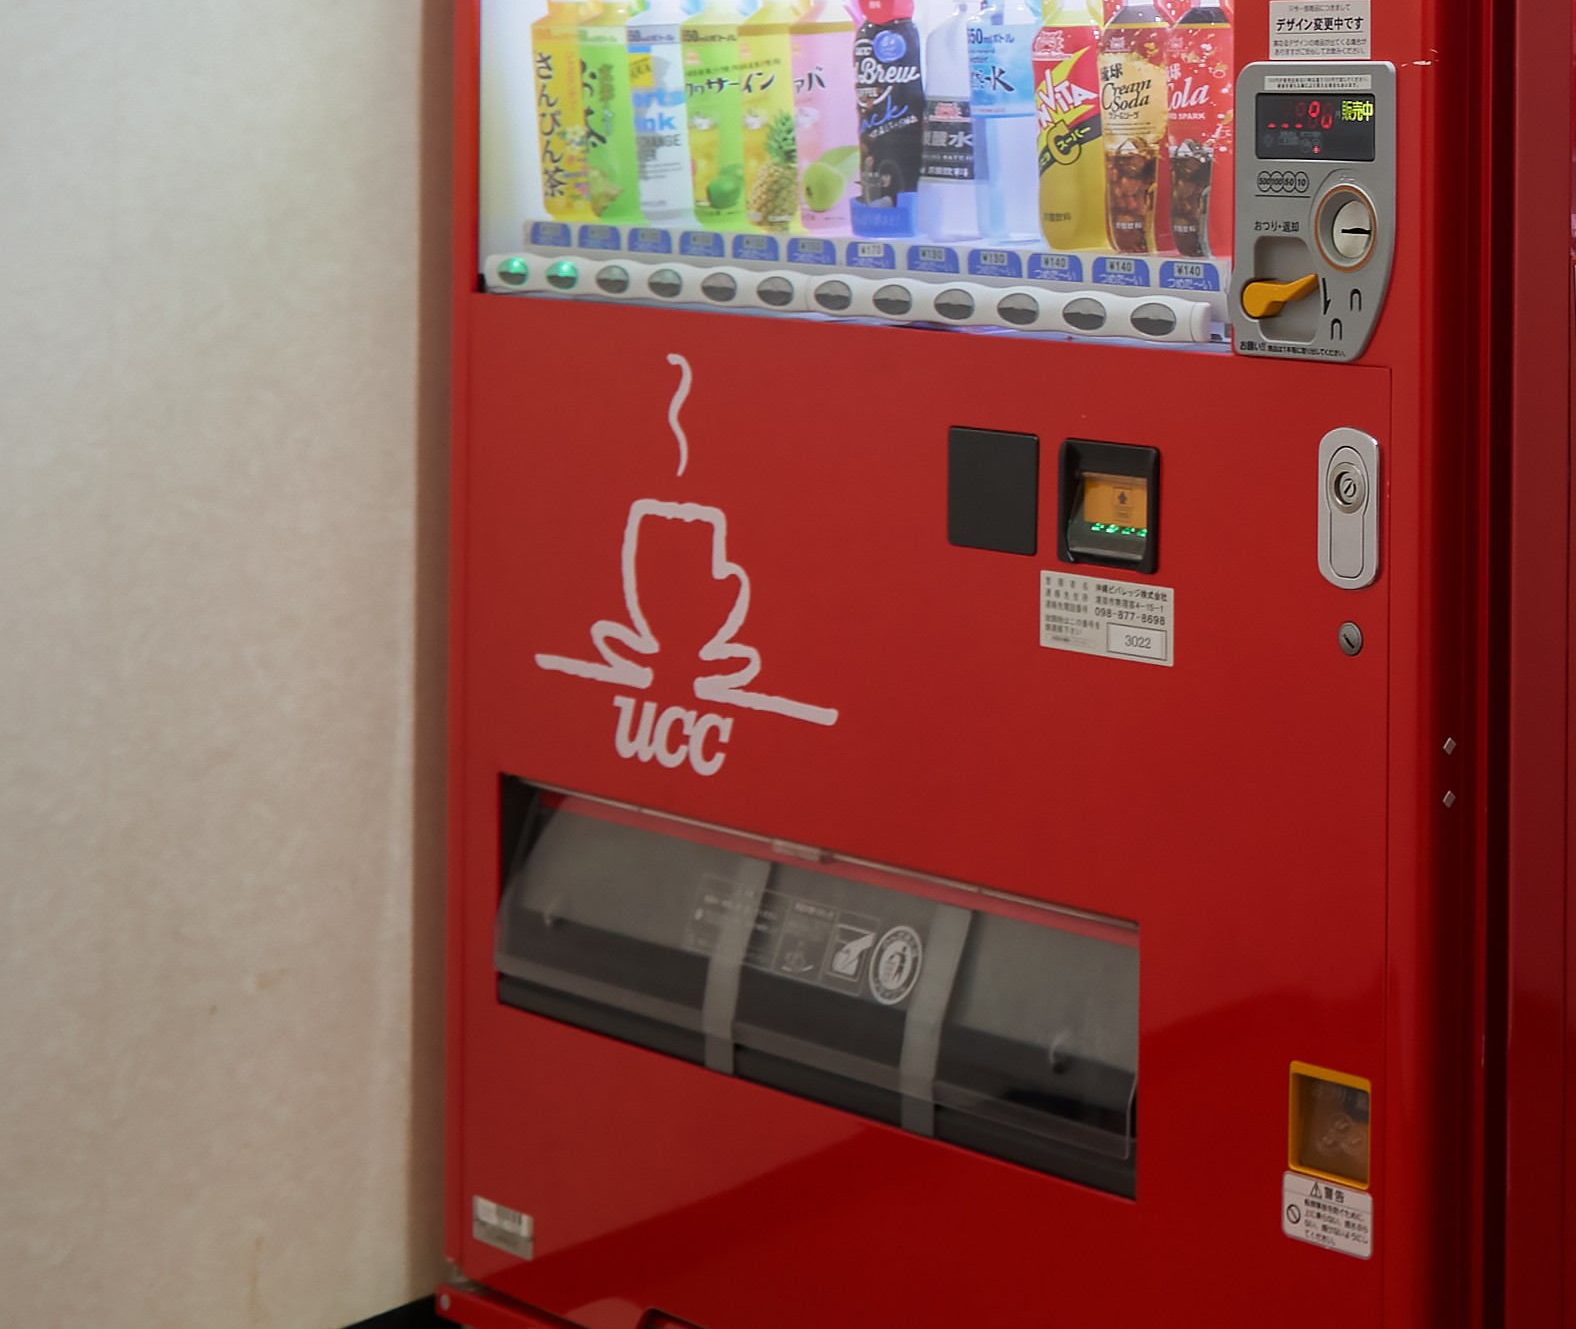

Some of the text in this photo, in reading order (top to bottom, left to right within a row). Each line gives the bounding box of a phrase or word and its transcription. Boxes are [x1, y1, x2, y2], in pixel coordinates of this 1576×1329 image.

[1276, 17, 1364, 32] デザイン変更中です
[1112, 93, 1149, 113] Soda
[1341, 100, 1374, 122] 販売中
[1177, 263, 1203, 277] ¥140
[1095, 606, 1166, 626] 098-877-8698
[1124, 634, 1152, 649] 3022
